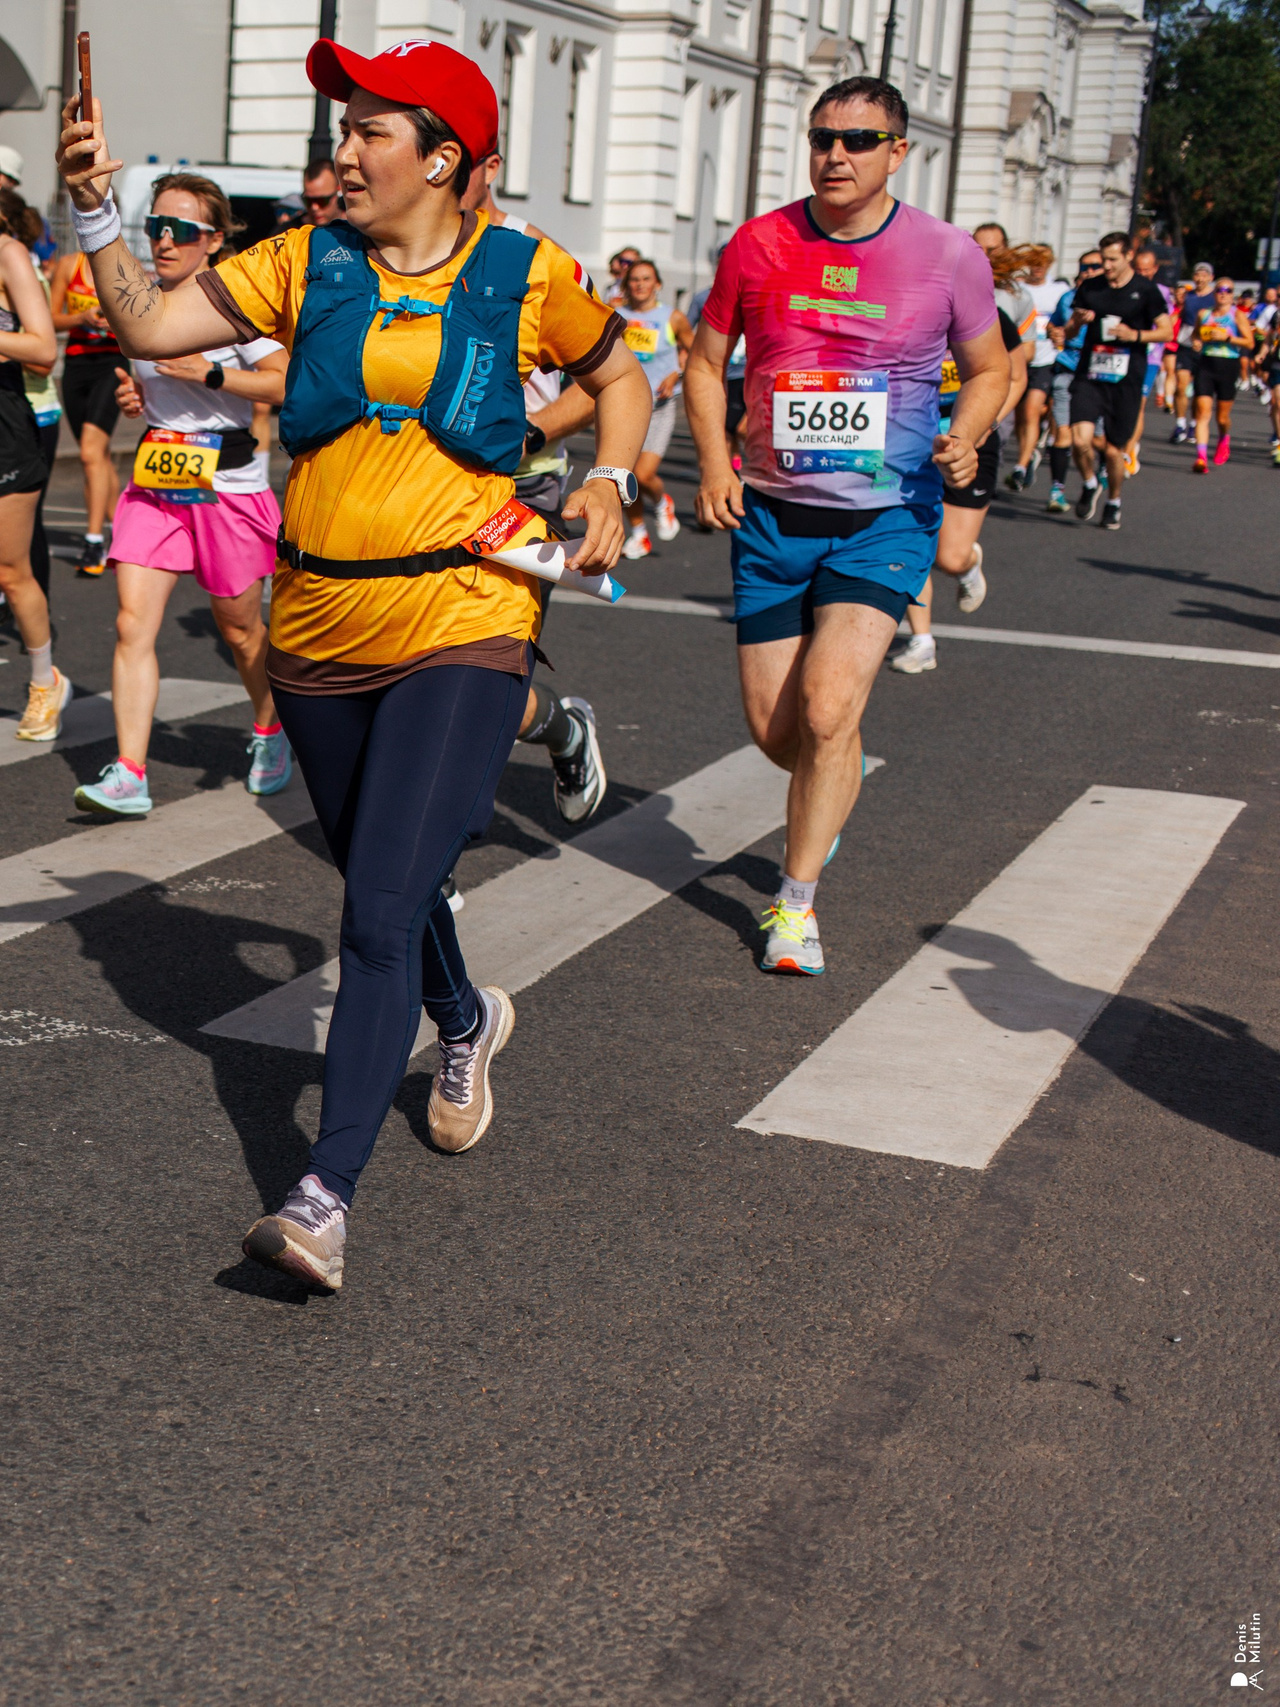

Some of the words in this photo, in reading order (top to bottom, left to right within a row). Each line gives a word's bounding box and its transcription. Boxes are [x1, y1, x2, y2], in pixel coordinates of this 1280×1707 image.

[838, 377, 855, 387] 21,1
[788, 401, 870, 431] 5686
[796, 435, 860, 445] АЛЕКСАНДР
[144, 449, 204, 477] 4893
[782, 451, 795, 469] D
[158, 477, 190, 485] МАРИНА
[477, 518, 498, 539] ПОЛУ
[482, 513, 518, 546] МАРАФОН
